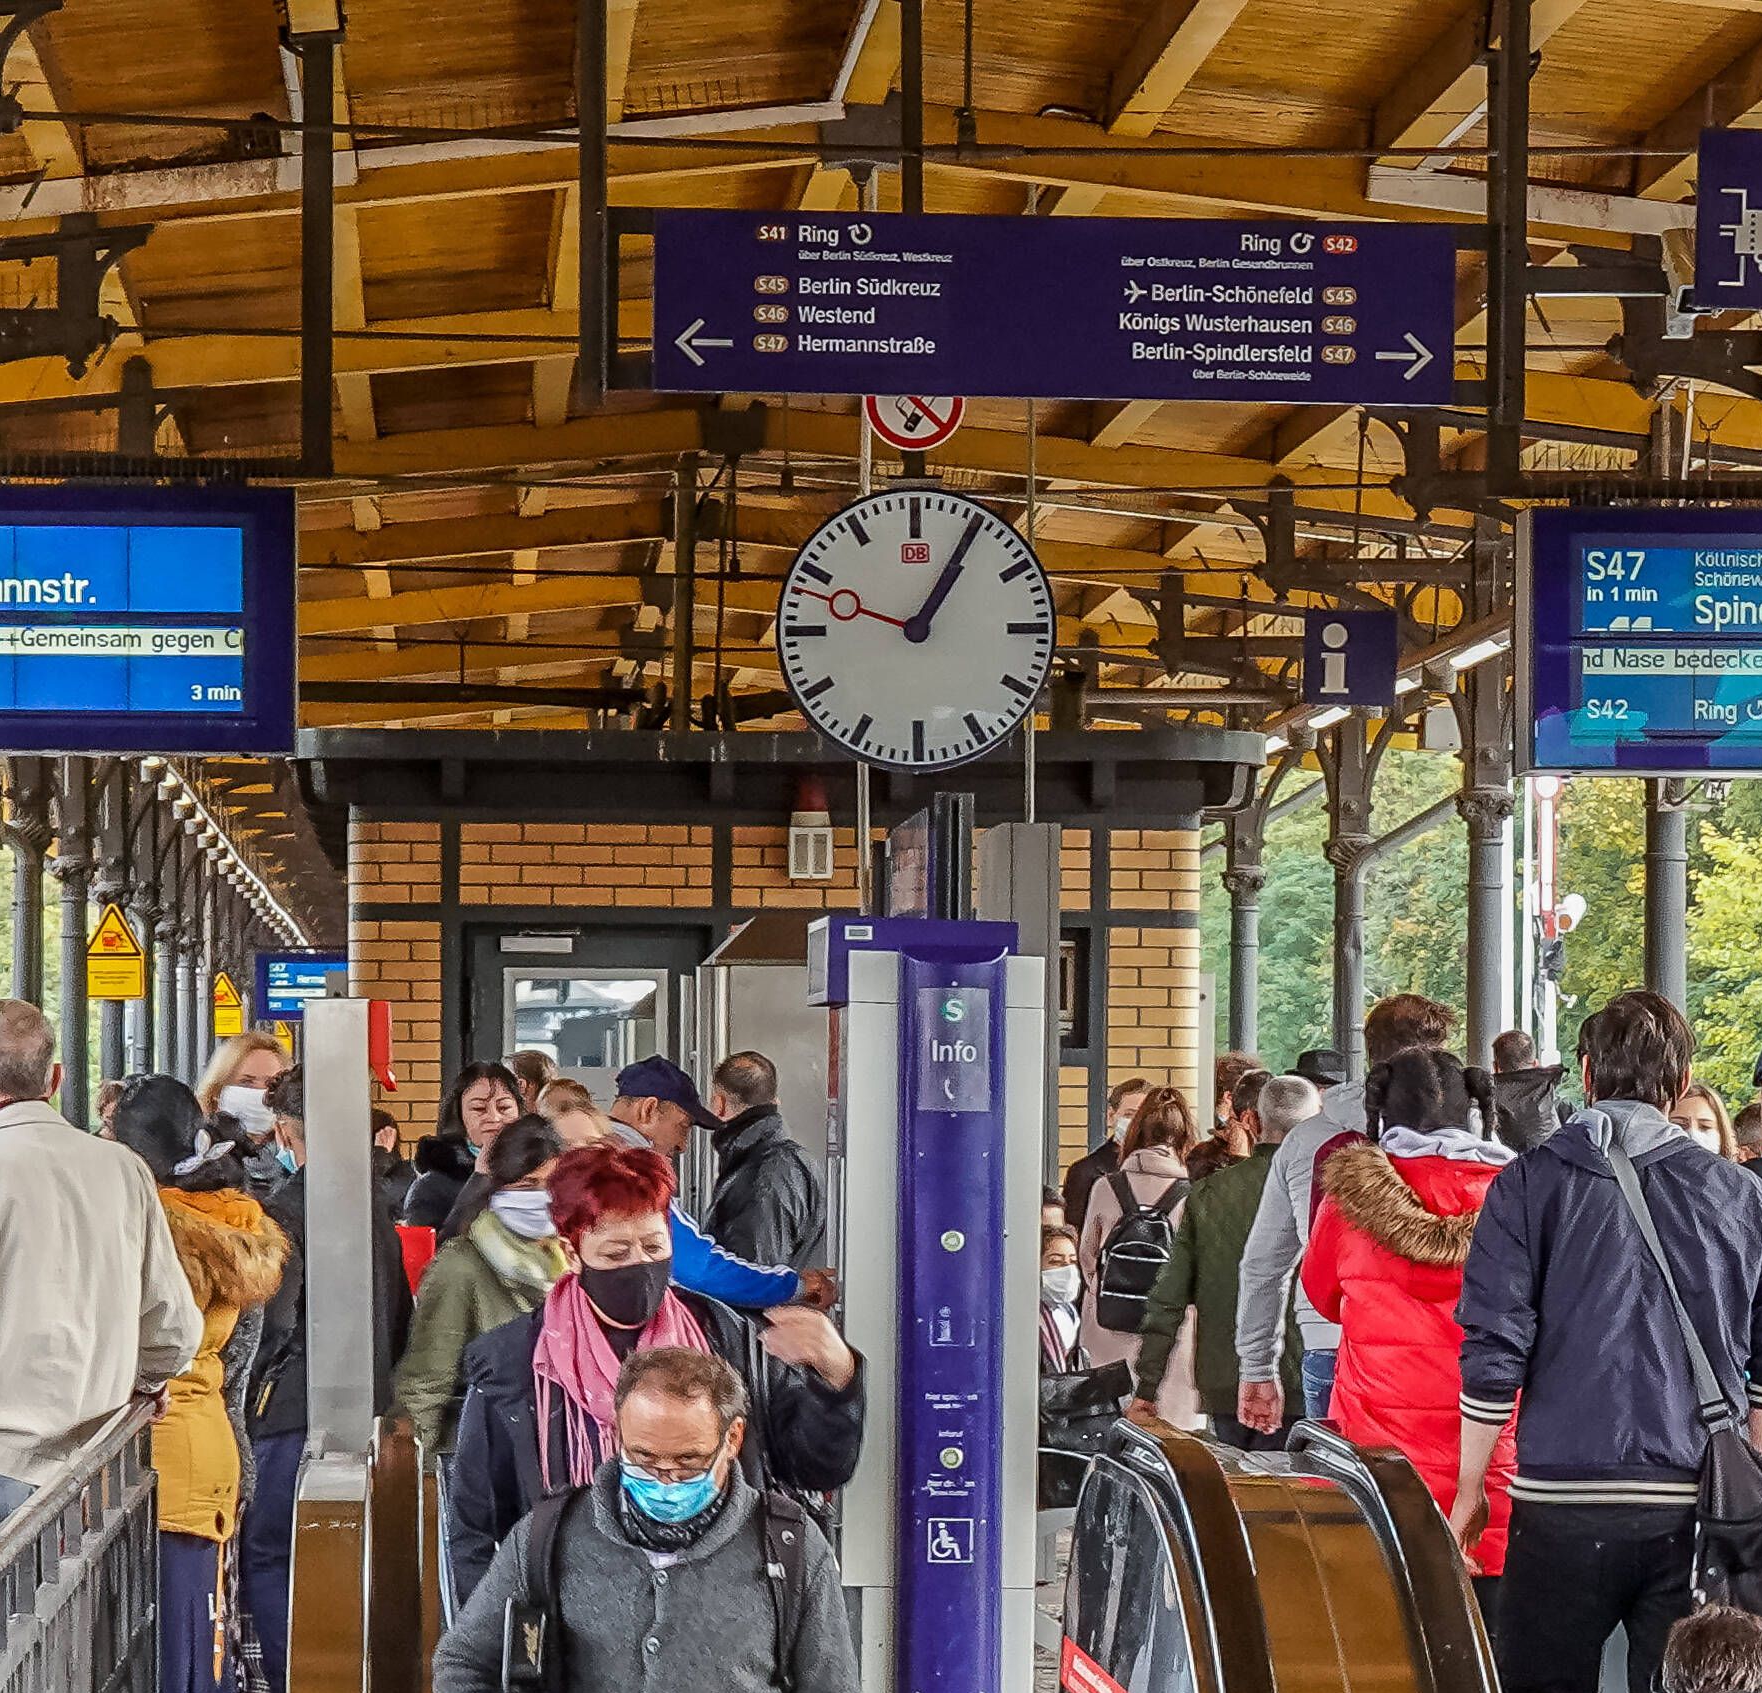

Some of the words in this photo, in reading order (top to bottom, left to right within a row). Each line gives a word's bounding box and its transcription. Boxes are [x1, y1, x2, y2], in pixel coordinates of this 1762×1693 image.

[758, 226, 787, 240] S41
[798, 225, 839, 246] Ring
[1241, 234, 1282, 256] Ring
[1325, 237, 1354, 252] S42
[823, 250, 851, 260] Berlin
[1199, 257, 1230, 268] Berlin
[758, 279, 785, 292] S45
[798, 277, 851, 294] Berlin
[856, 277, 941, 296] Südkreuz
[1151, 284, 1313, 304] Berlin-Schönefeld
[1325, 290, 1353, 303] S45
[758, 307, 785, 321] S46
[798, 306, 875, 324] Westend
[1119, 312, 1180, 334] Königs
[1185, 314, 1312, 333] Wusterhausen
[1325, 319, 1353, 332] S46
[757, 336, 784, 350] S47
[798, 335, 936, 354] Hermannstraße
[1132, 342, 1312, 364] Berlin-Spindlersfeld
[1325, 349, 1352, 362] S47
[903, 545, 929, 562] DB
[1587, 551, 1646, 581] S47
[1586, 586, 1604, 602] in
[1610, 587, 1619, 602] 1
[1625, 586, 1658, 602] min
[152, 632, 215, 653] gegen
[1613, 651, 1665, 668] Nase
[190, 684, 203, 701] 3
[207, 684, 242, 700] min
[1587, 699, 1628, 719] S42
[1694, 700, 1737, 725] Ring
[932, 1040, 977, 1063] Info
